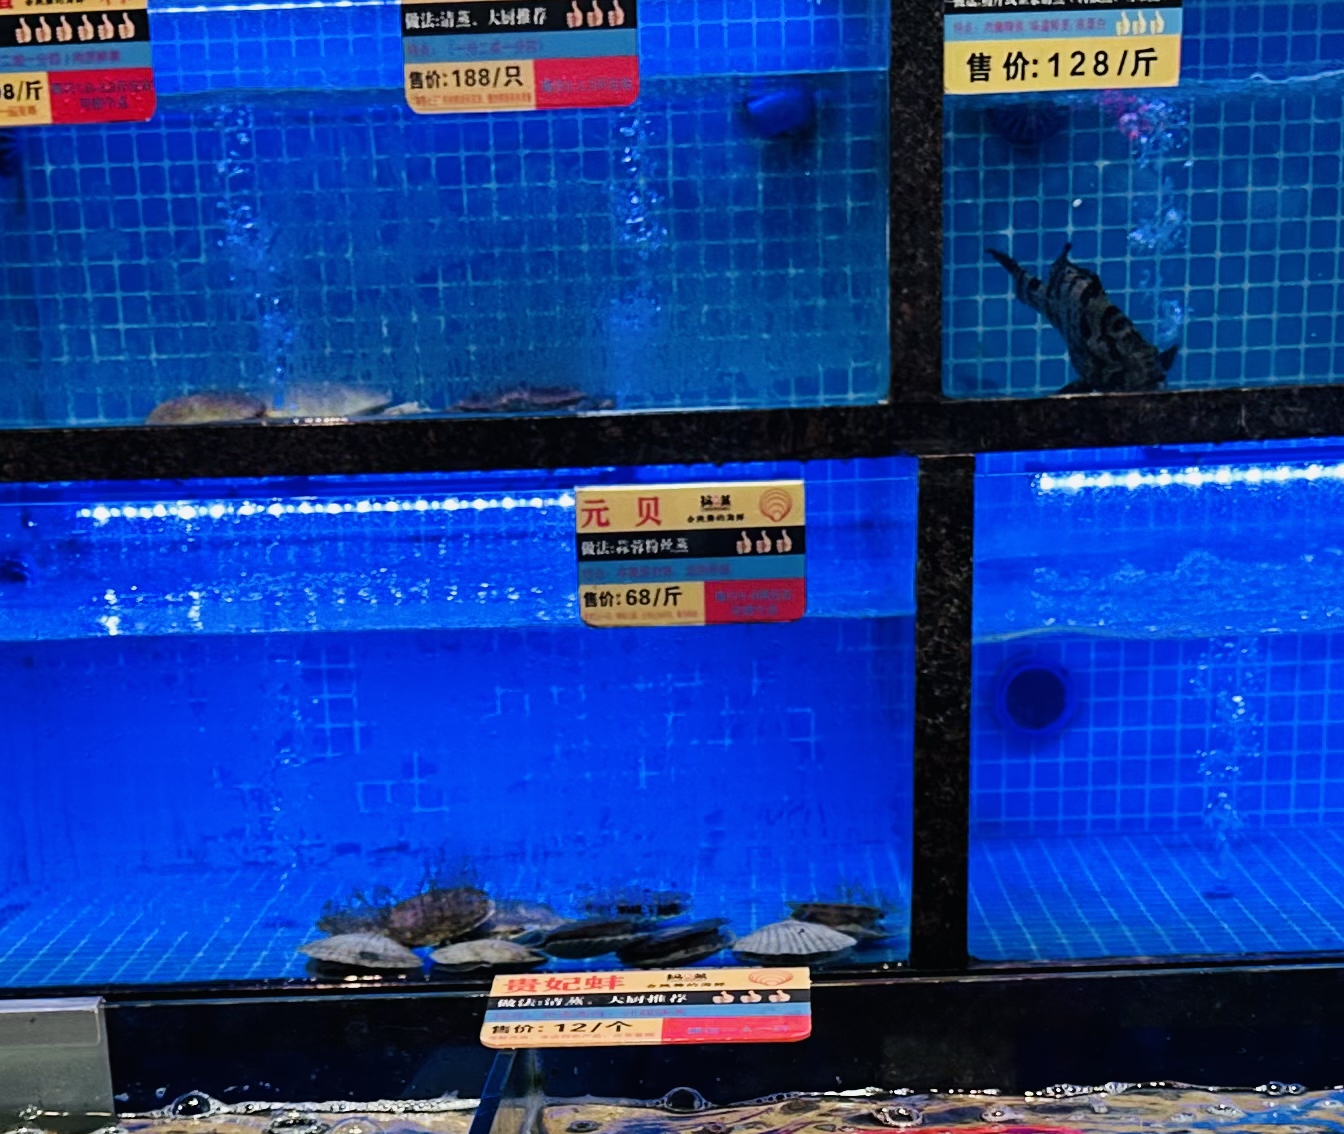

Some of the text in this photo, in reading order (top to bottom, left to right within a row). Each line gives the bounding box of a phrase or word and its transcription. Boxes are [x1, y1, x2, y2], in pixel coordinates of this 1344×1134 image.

[409, 65, 523, 90] 售价:188/只
[966, 47, 1158, 83] 售价:128/斤
[581, 496, 662, 529] 元贝
[584, 586, 682, 608] 售价:68/斤
[504, 975, 625, 994] 贵妃蚌
